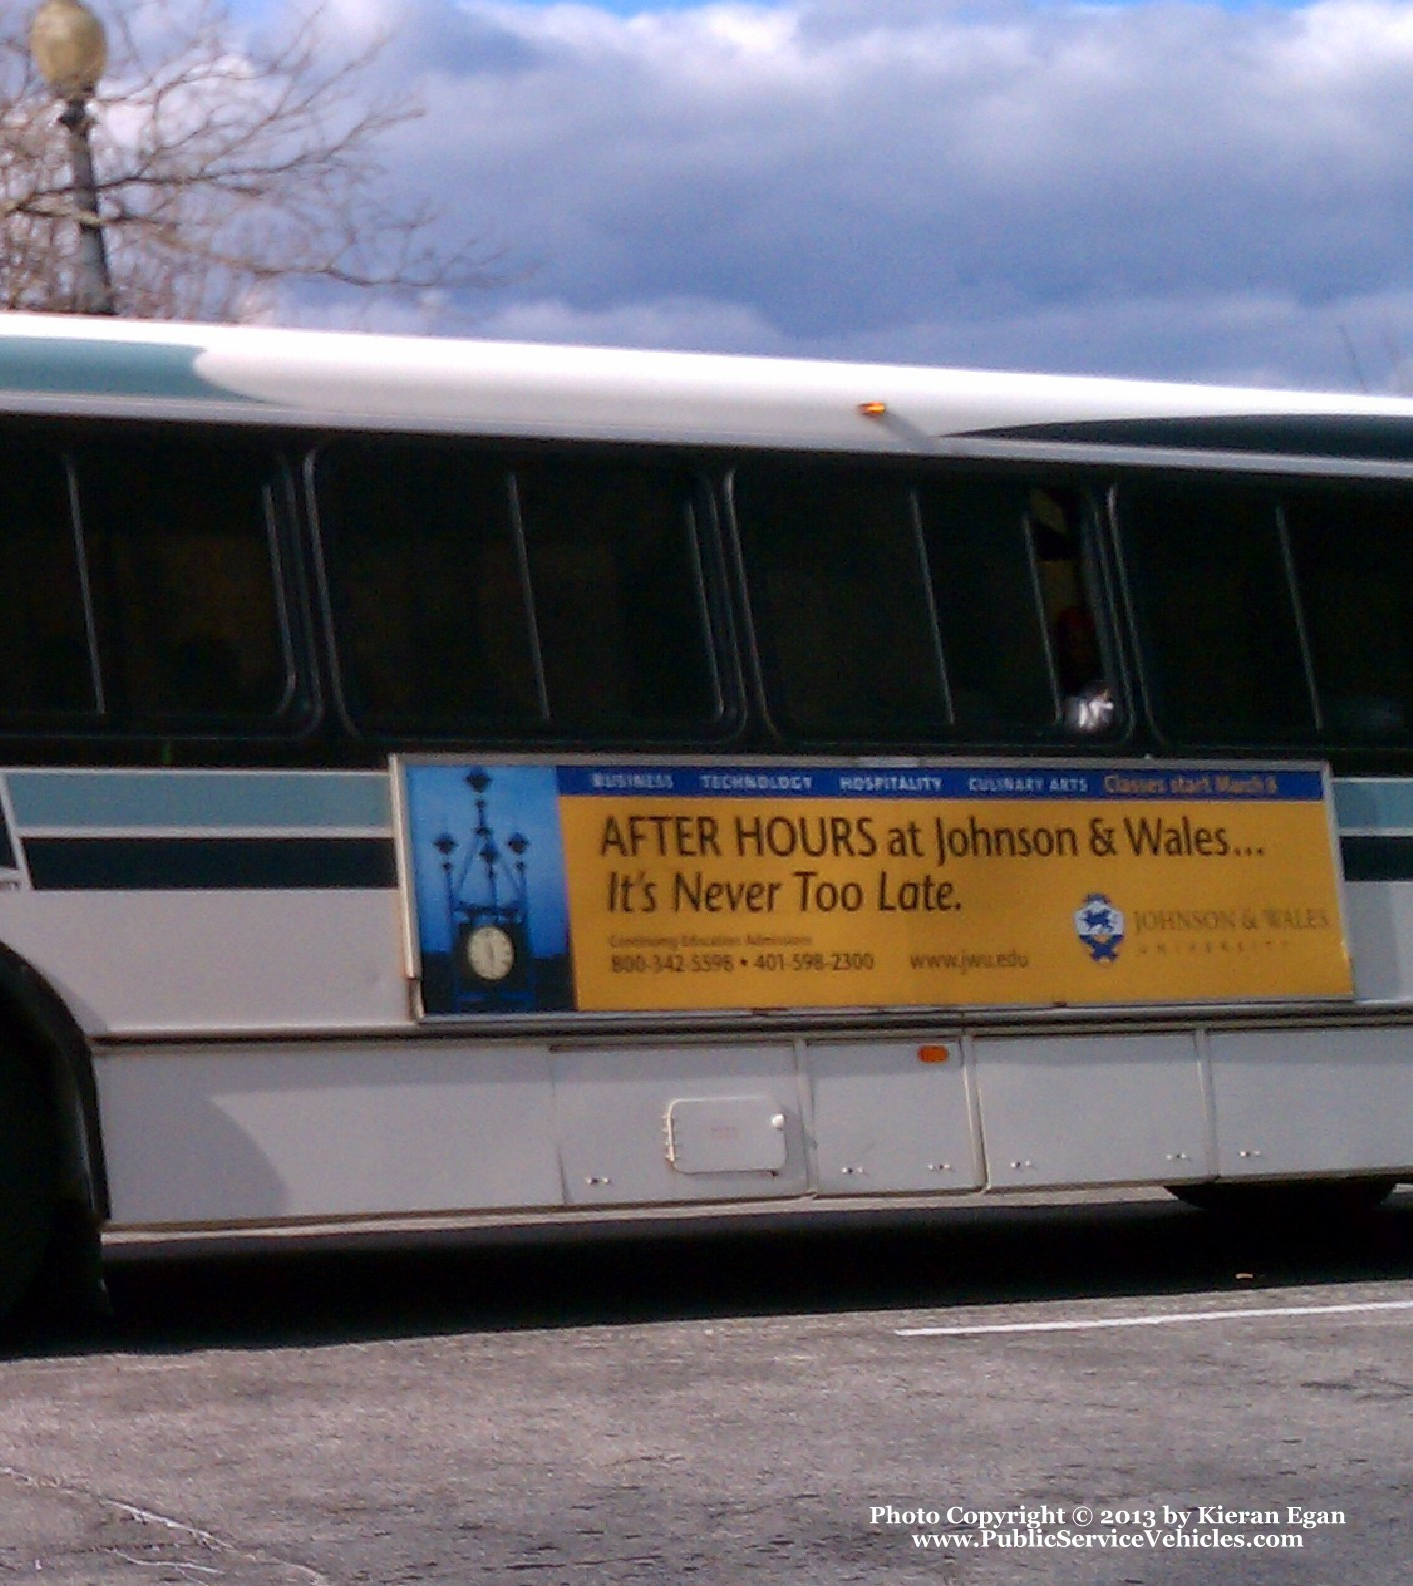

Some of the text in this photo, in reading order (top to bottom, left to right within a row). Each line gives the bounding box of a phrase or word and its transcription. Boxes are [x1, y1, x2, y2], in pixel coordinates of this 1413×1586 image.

[591, 773, 674, 789] BUSINESS
[700, 774, 813, 790] TECHNOLOGY
[840, 775, 942, 790] HOSPITALITY
[968, 777, 1044, 792] CULINARY
[1049, 777, 1088, 792] ARTS
[601, 815, 1265, 867] AFTER HOURS at Johnson & Wales...
[608, 871, 961, 912] It's Never Too Late.
[1134, 908, 1330, 934] JOHNSON & WALES
[754, 953, 874, 971] 401-598-2300
